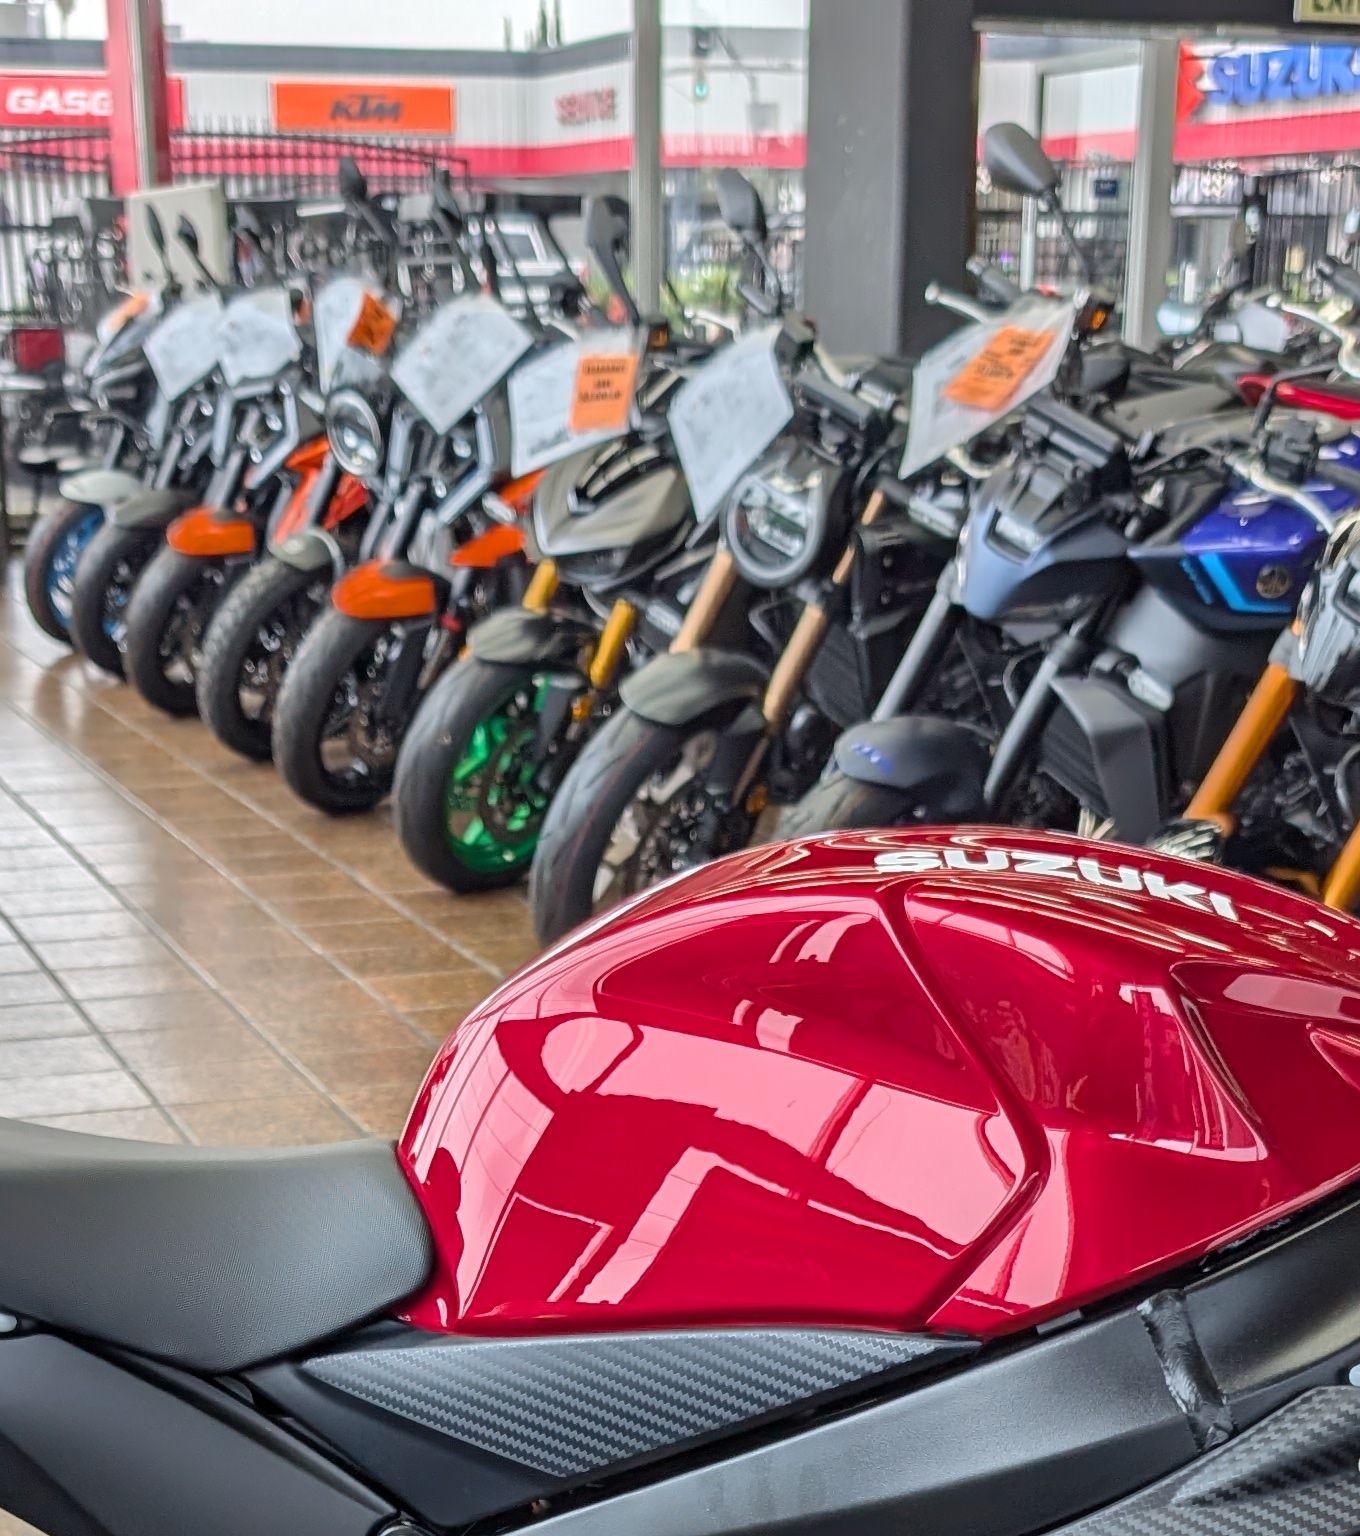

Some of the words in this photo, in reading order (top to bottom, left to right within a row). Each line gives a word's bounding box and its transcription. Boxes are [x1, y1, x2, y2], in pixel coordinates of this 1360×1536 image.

[6, 87, 113, 116] GASG
[330, 93, 403, 122] KTM
[874, 848, 1240, 921] SUZUKI
